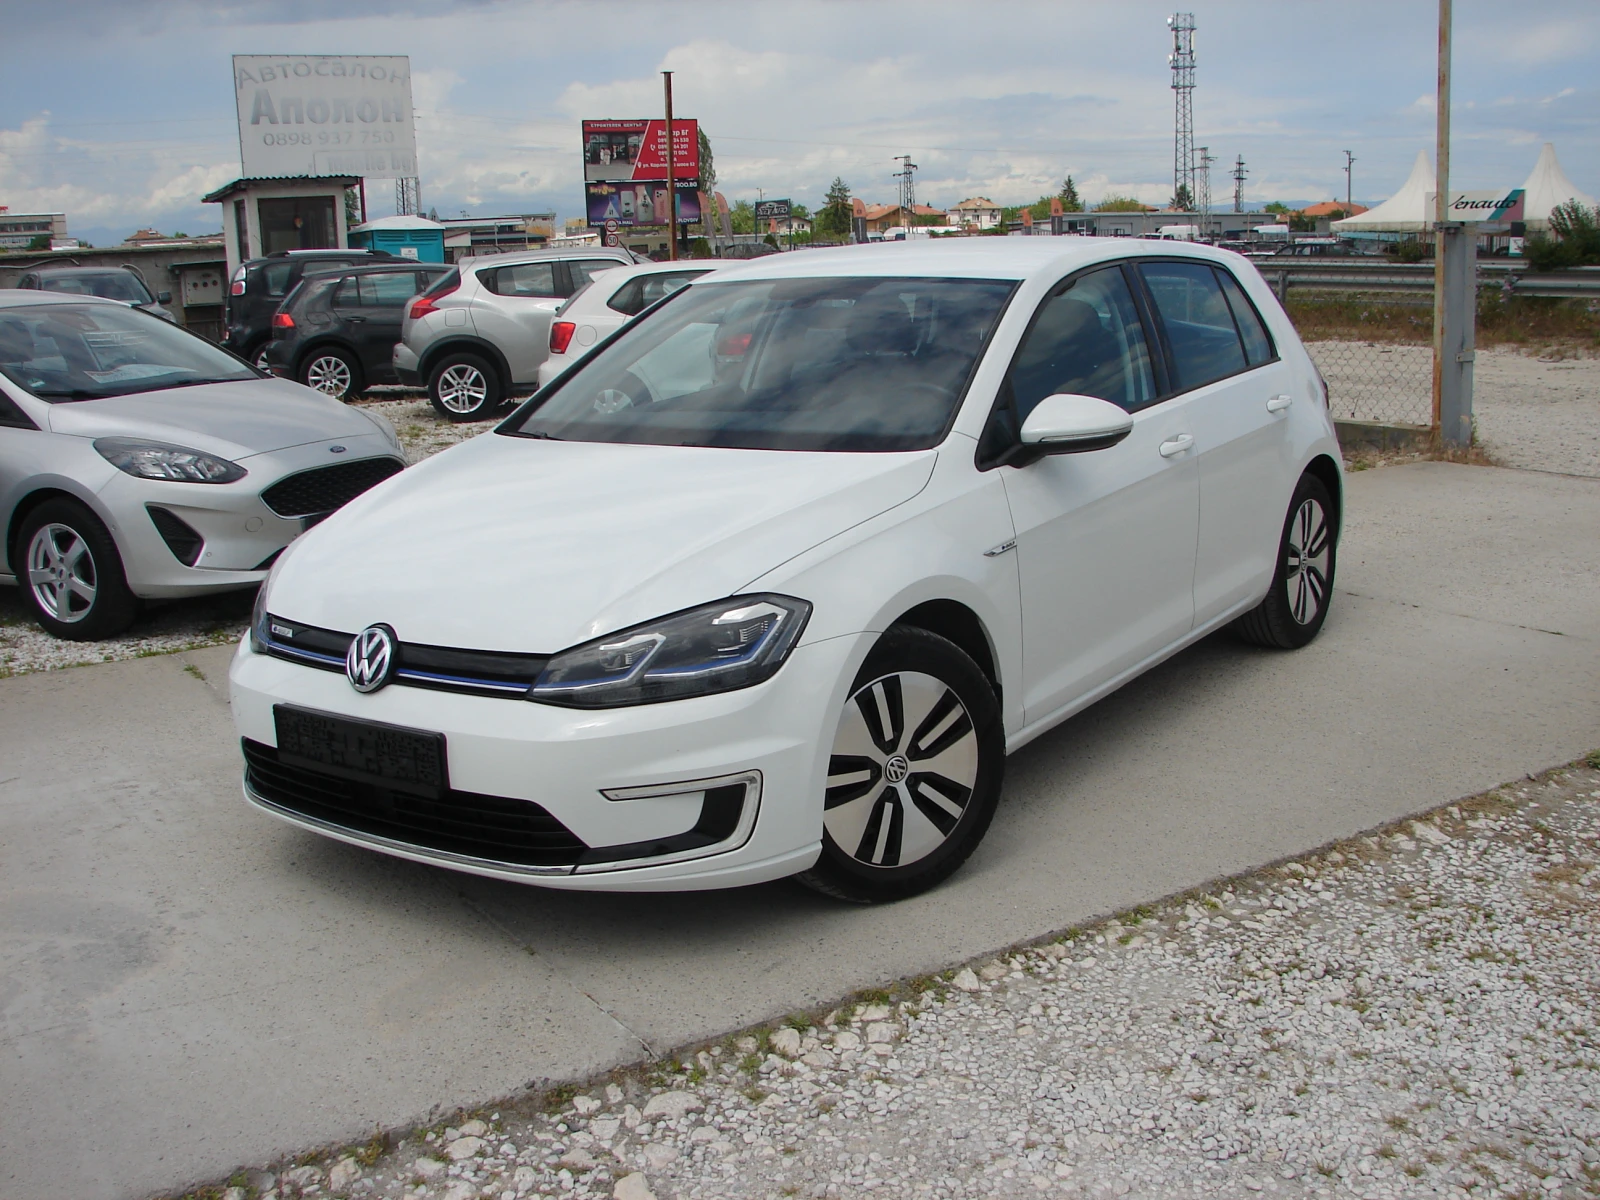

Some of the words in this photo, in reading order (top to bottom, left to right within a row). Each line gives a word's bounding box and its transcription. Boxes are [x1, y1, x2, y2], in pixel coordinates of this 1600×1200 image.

[237, 60, 408, 90] Автосалон
[250, 88, 405, 125] Аполон
[263, 132, 312, 147] 0898
